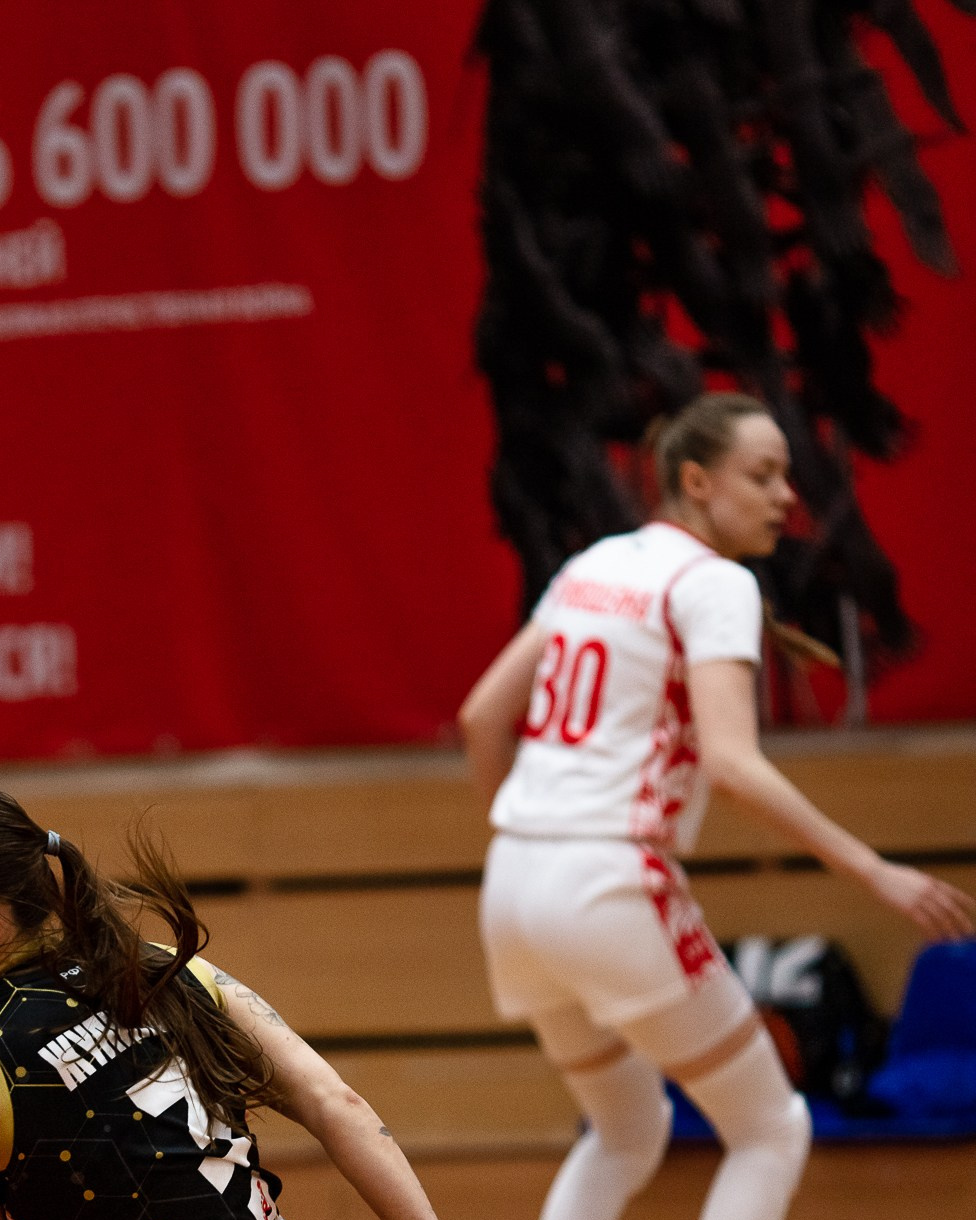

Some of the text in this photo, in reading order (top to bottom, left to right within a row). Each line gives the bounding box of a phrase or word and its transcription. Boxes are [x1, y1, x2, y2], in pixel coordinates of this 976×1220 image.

[32, 67, 216, 208] 600
[235, 49, 428, 191] 000
[516, 631, 608, 746] 30
